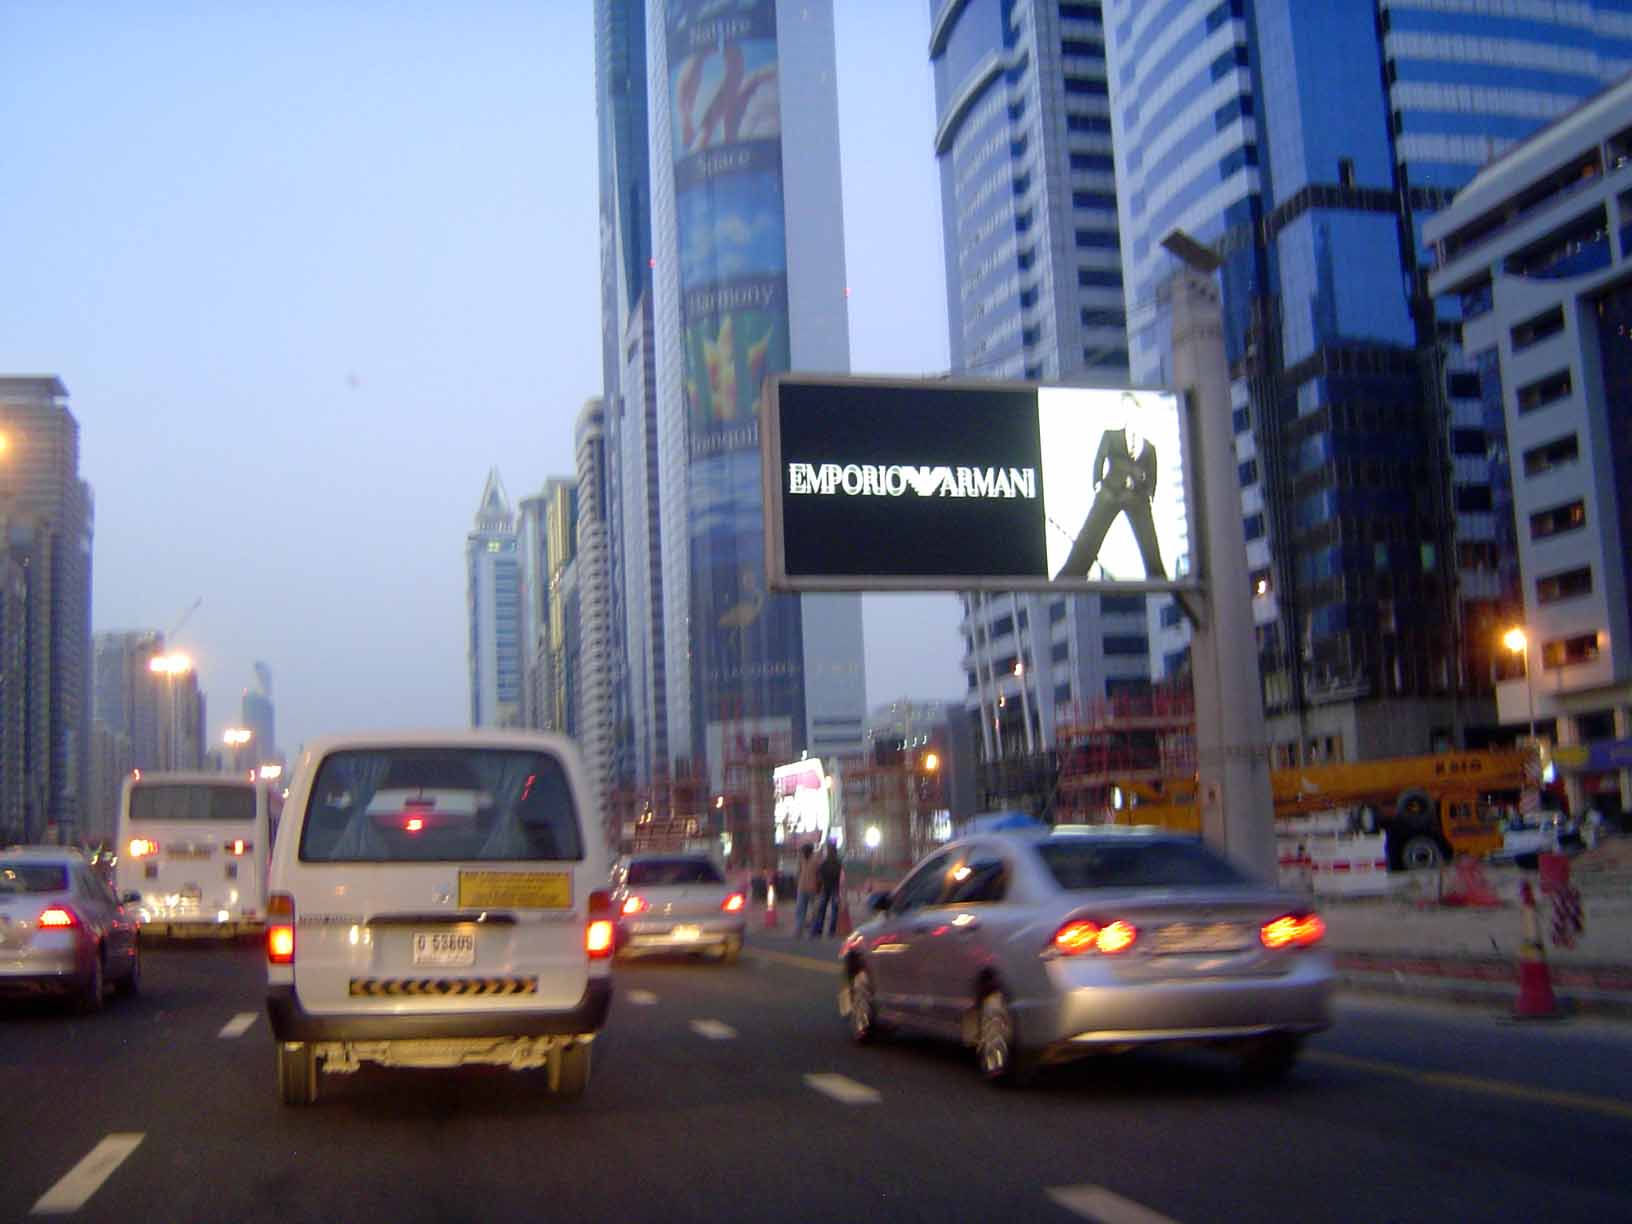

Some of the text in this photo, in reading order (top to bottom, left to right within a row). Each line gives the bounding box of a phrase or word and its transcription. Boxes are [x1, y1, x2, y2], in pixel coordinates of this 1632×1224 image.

[688, 283, 776, 315] Harmony
[788, 462, 1037, 499] EMPORIO ARMANI
